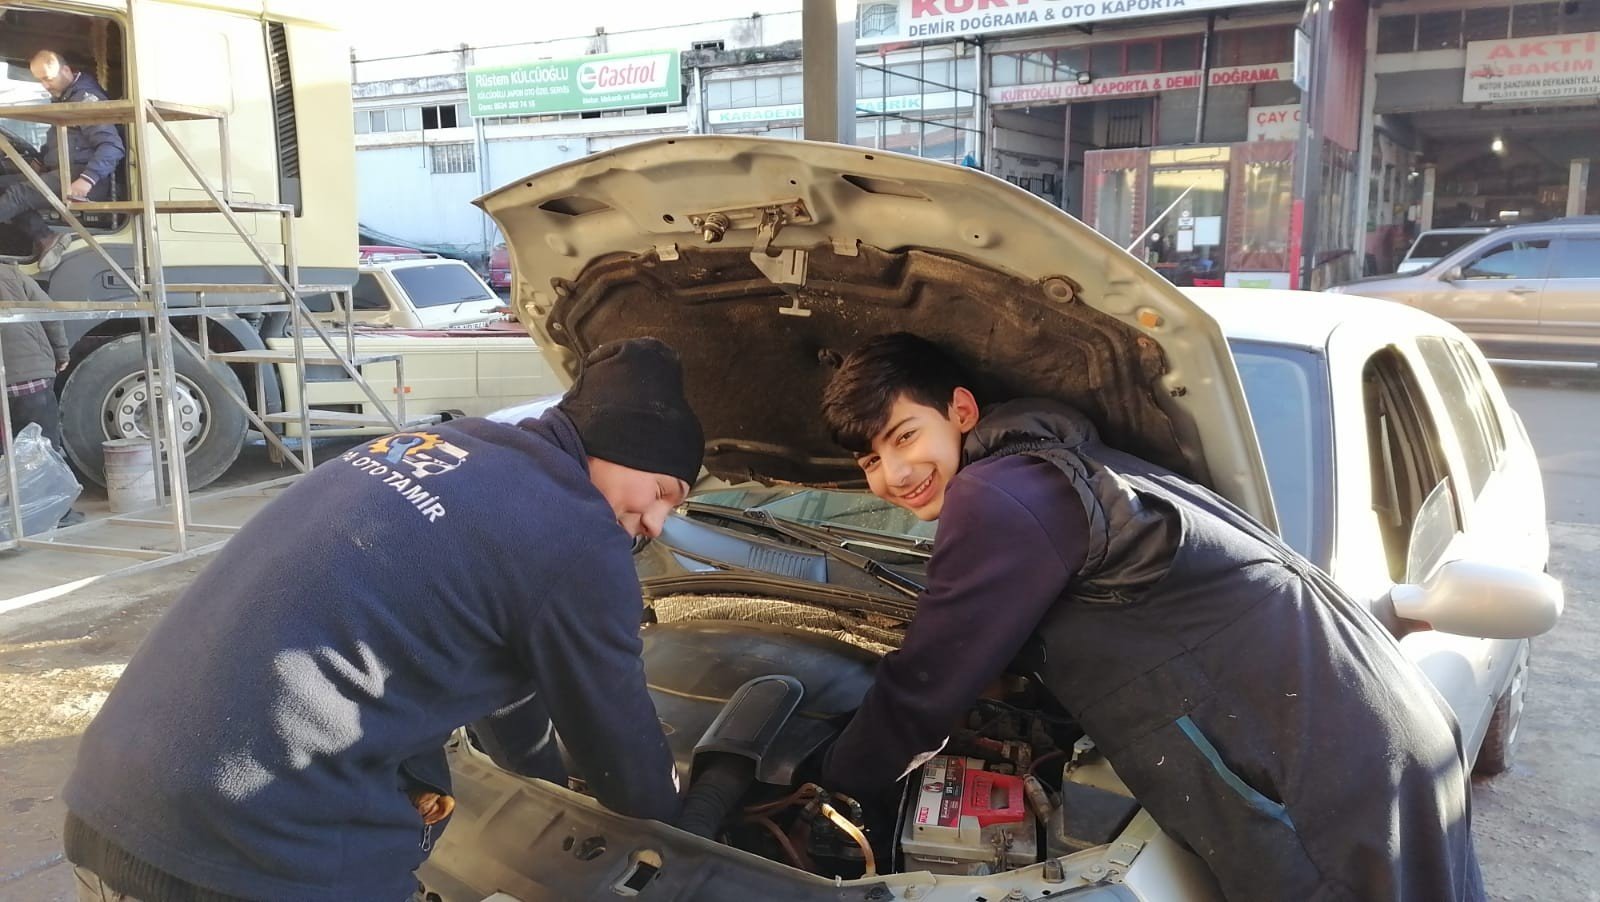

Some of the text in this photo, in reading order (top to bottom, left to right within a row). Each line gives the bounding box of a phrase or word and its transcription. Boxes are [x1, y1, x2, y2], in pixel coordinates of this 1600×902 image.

[909, 18, 955, 37] DEMİR
[961, 10, 1039, 31] DOĞRAMA
[1044, 8, 1056, 20] &
[1062, 4, 1095, 19] OTO
[475, 65, 569, 88] Rüstem KÜLCÜOĞLU
[599, 61, 656, 88] Castrol
[1508, 60, 1593, 76] BAKIM
[1001, 84, 1061, 101] KURTOĞLU
[1065, 85, 1089, 97] OTO
[1092, 79, 1148, 96] KAPORTA
[1152, 78, 1161, 89] &
[1212, 68, 1280, 84] DOĞRAMA
[719, 106, 803, 121] KARADENİ
[1256, 111, 1288, 126] ÇAY
[352, 456, 446, 523] OTO TAMİR
